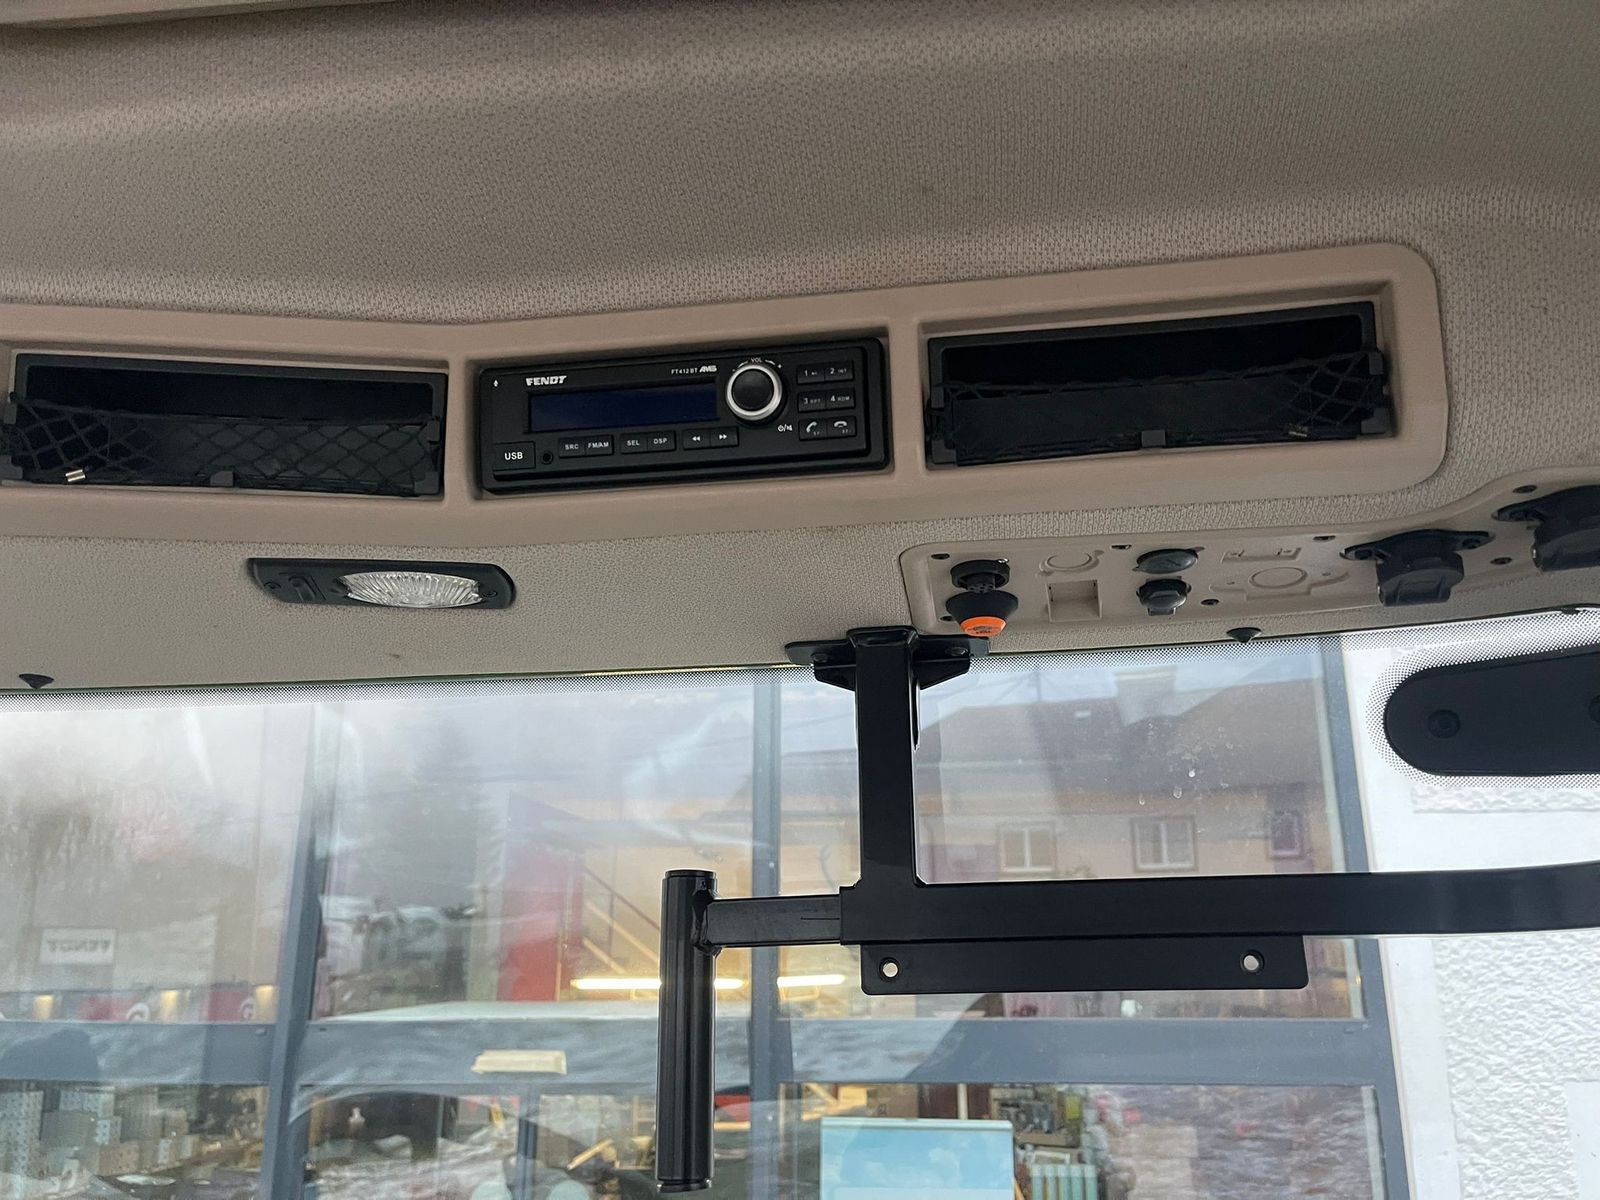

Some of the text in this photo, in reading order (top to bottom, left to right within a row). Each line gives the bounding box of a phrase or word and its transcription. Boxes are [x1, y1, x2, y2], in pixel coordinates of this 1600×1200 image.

[829, 367, 835, 375] 2
[525, 375, 567, 386] FENDT
[804, 397, 809, 405] 3
[587, 441, 609, 449] FM/AM
[653, 437, 668, 445] DSP
[564, 443, 579, 451] SRC
[504, 451, 524, 461] USB
